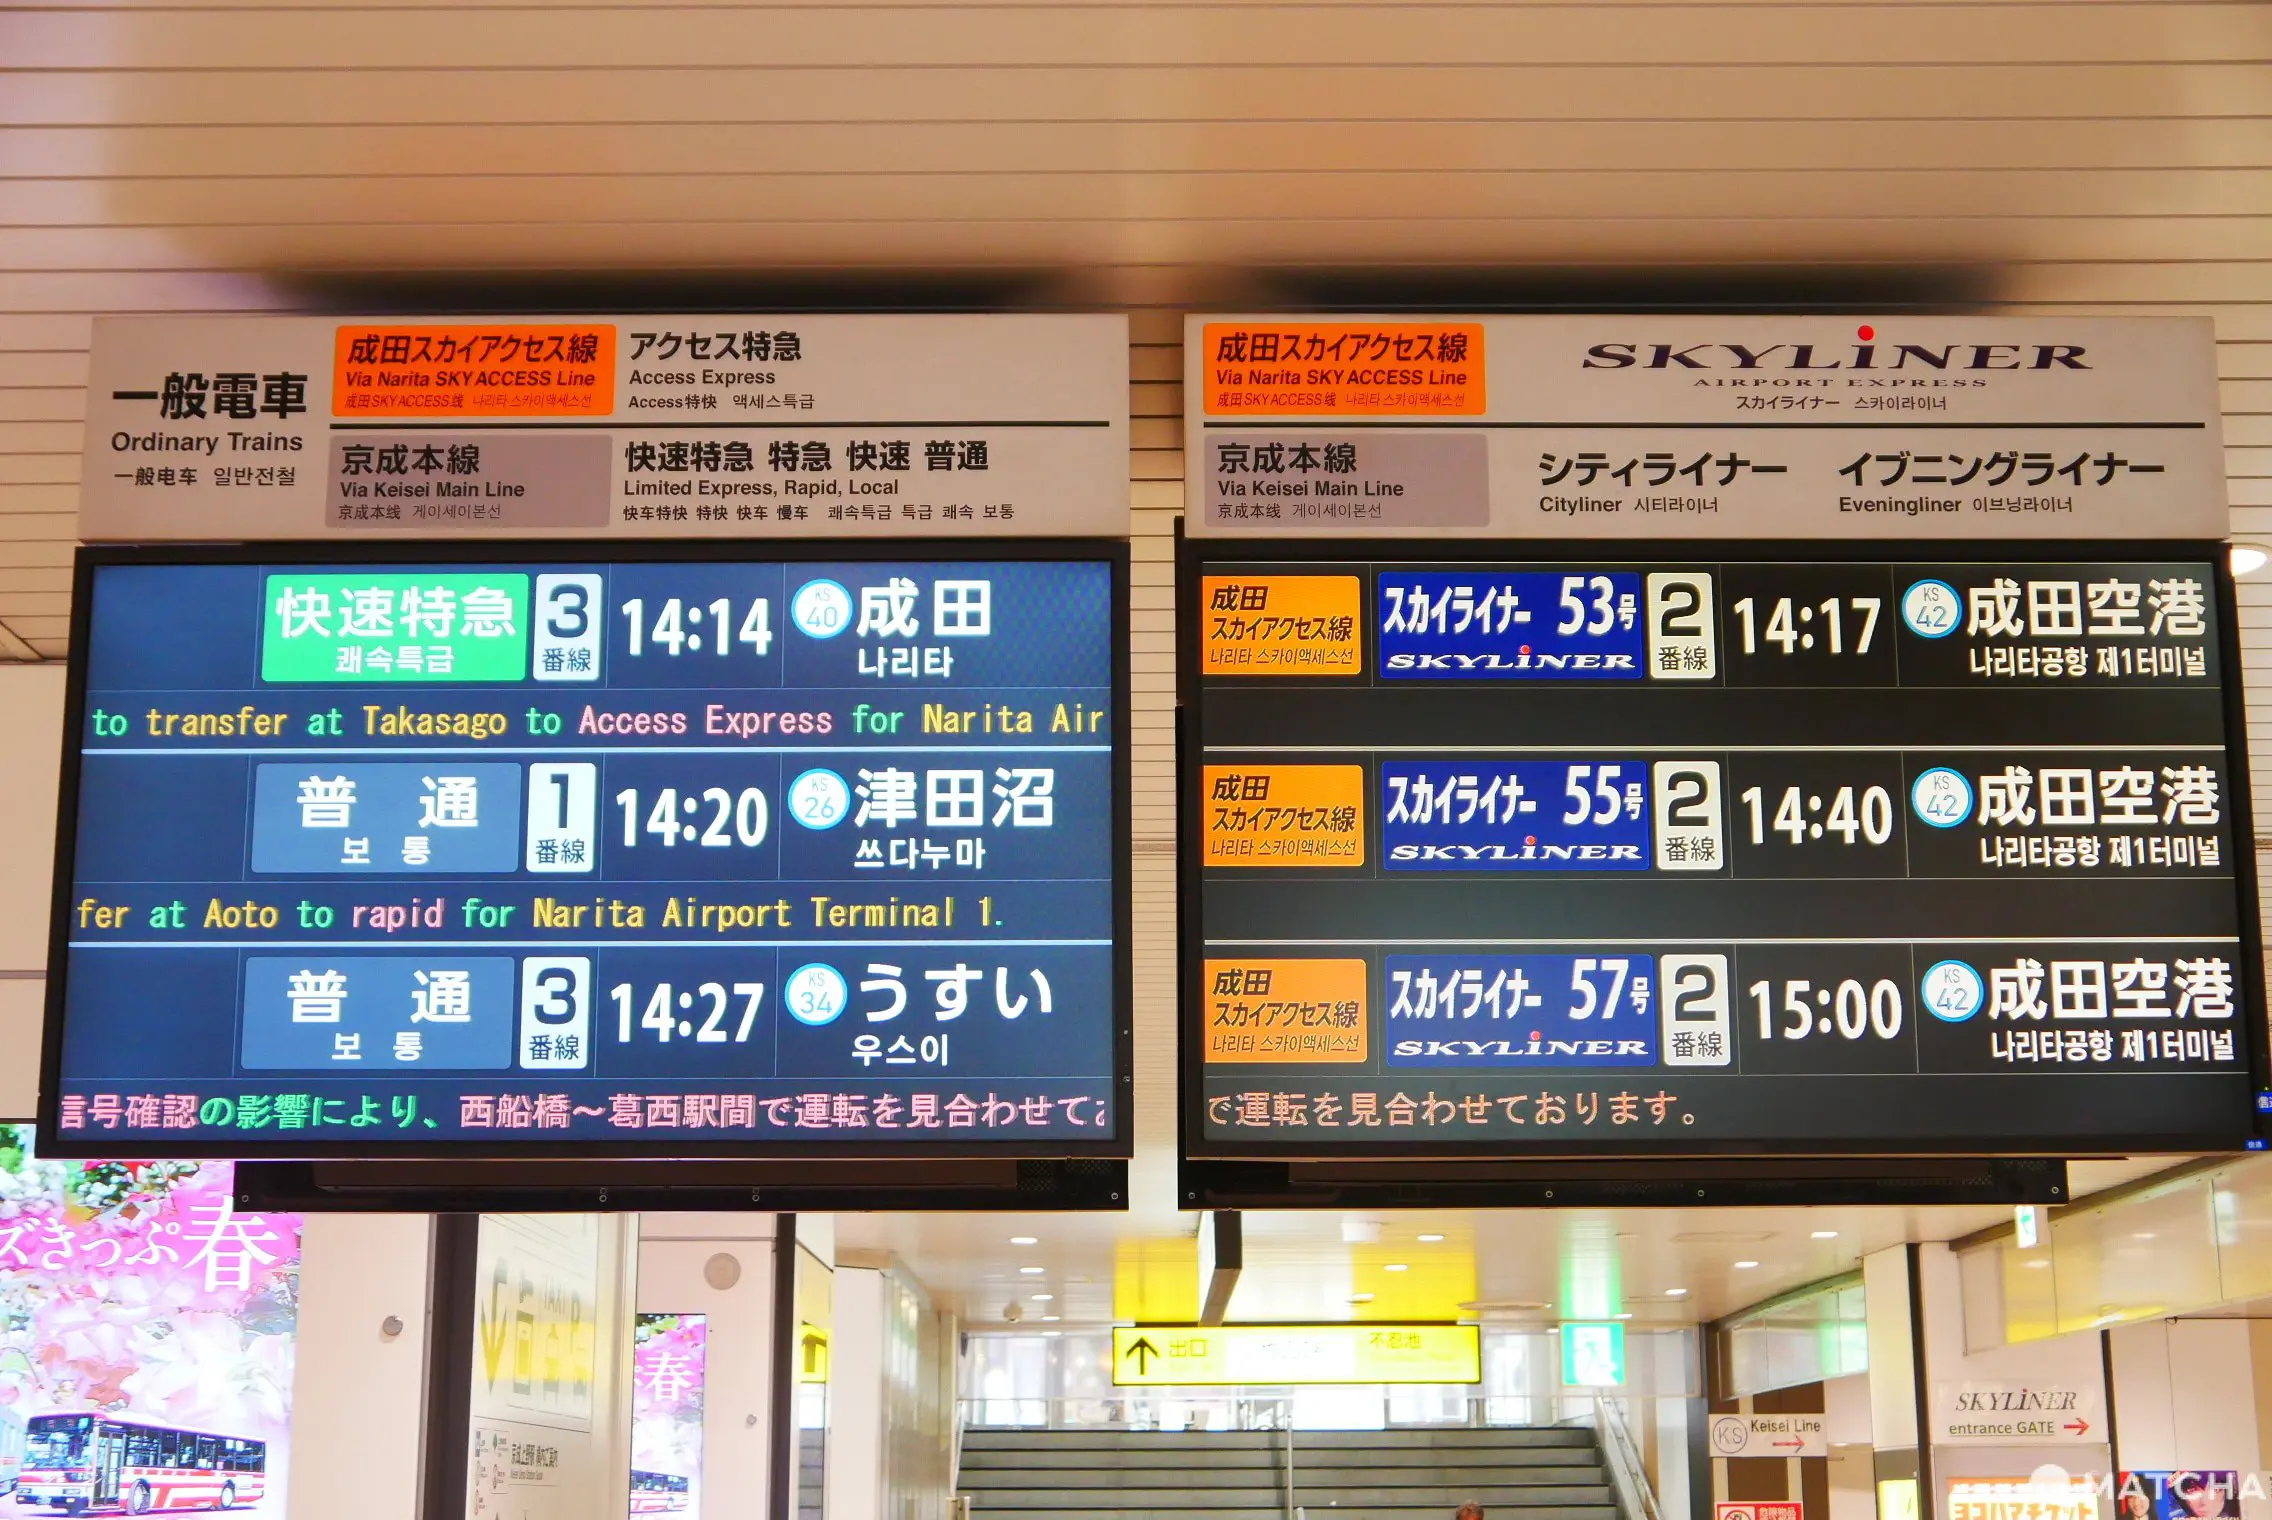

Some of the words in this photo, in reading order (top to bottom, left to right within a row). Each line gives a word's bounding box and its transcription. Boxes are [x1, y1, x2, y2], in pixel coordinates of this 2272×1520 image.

[348, 334, 598, 364] 成田スカイアクセス線
[630, 331, 801, 361] アクセス特急
[1217, 332, 1468, 363] 成田スカイアクセス線
[345, 371, 371, 387] Via
[377, 371, 429, 387] Narita
[557, 371, 595, 387] Line
[629, 369, 695, 384] Access
[702, 369, 775, 387] Express
[1216, 370, 1242, 385] Via
[1249, 370, 1300, 385] Narita
[1429, 370, 1466, 385] Line
[1693, 379, 1835, 387] AIRPORT
[1847, 379, 1988, 387] EXPRESS
[113, 372, 307, 419] 一般電車
[628, 394, 717, 409] Access特快
[733, 394, 815, 409] 액세스특급
[1737, 396, 1840, 410] スカイライナー
[1854, 396, 1947, 410] 스카이라이너
[111, 432, 219, 456] Ordinary
[227, 432, 303, 451] Trains
[625, 440, 753, 472] 快速特急
[768, 440, 832, 472] 特急
[846, 440, 910, 472] 快速
[924, 440, 989, 471] 普通
[1217, 442, 1357, 474] 京成本線
[341, 444, 480, 475] 京成本線
[1539, 452, 1787, 487] シティライナー
[1839, 451, 2164, 487] イブニングライナー
[114, 467, 197, 486] 一般电车
[214, 467, 295, 486] 일반전철
[340, 482, 368, 497] Via
[374, 482, 429, 497] Keisei
[436, 482, 479, 497] Main
[486, 482, 525, 497] Line
[624, 480, 692, 496] Limited
[698, 480, 778, 499] Express,
[784, 479, 842, 499] Rapid,
[849, 479, 898, 495] Local
[1217, 480, 1246, 496] Via
[1252, 480, 1308, 496] Keisei
[1315, 480, 1358, 496] Main
[1365, 480, 1404, 496] Line
[338, 505, 400, 520] 京成本线
[412, 504, 501, 519] 게이세이본선
[623, 505, 688, 521] 快车特快
[696, 505, 728, 521] 特快
[737, 505, 768, 520] 快车
[777, 505, 808, 520] 慢车
[828, 504, 891, 520] 쾌속특급
[901, 504, 932, 520] 특급
[942, 504, 973, 520] 쾌속
[983, 504, 1014, 520] 보통
[1217, 503, 1281, 519] 京成本线
[1293, 503, 1381, 519] 게이세이본선
[1540, 496, 1622, 515] Cityliner
[1634, 496, 1718, 514] 시티라이너
[1839, 497, 1962, 516] Eveningliner
[1973, 496, 2073, 513] 이브닝라이너
[1211, 584, 1269, 612] 成田
[1923, 587, 1939, 601] KS
[1966, 578, 2206, 637] 成田空港
[275, 585, 516, 639] 快速特急
[547, 583, 588, 639] 3
[806, 607, 837, 628] 40
[1383, 584, 1531, 635] スカイライナー
[1660, 582, 1702, 637] 2
[1916, 605, 1948, 628] 42
[621, 597, 773, 656] 14:14
[1210, 615, 1353, 642] スカイアクセス線
[1734, 597, 1882, 654] 14:17
[335, 645, 455, 674] 쾌속특급
[542, 647, 591, 673] 番線
[859, 646, 954, 678] 나리타
[1659, 645, 1709, 671] 番線
[1970, 646, 2087, 678] 나리타공항
[2097, 646, 2206, 678] 제1터미널
[92, 707, 128, 736] to
[146, 706, 288, 736] transfer
[307, 708, 343, 736] at
[364, 706, 507, 740] Takasago
[525, 708, 561, 736] to
[578, 705, 687, 735] Access
[705, 704, 833, 740] Express
[852, 704, 904, 734] for
[922, 704, 1032, 734] Narita
[1051, 705, 1104, 734] Air
[1211, 774, 1270, 802] 成田
[1933, 775, 1950, 790] KS
[1977, 765, 2220, 827] 成田空港
[549, 773, 570, 829] 1
[803, 798, 836, 819] 26
[854, 767, 1055, 828] 津田沼
[1387, 775, 1536, 825] スカイライナー
[1667, 770, 1709, 827] 2
[1927, 795, 1958, 817] 42
[616, 787, 769, 847] 14:20
[1211, 805, 1356, 833] スカイアクセス線
[1741, 785, 1893, 845] 14:40
[535, 837, 586, 865] 番線
[854, 838, 986, 870] 쓰다누마
[1665, 836, 1716, 863] 番線
[1980, 835, 2100, 868] 나리타공항
[2109, 835, 2220, 868] 제1터미널
[77, 899, 130, 929] fer
[149, 901, 187, 929] at
[203, 899, 280, 929] Aoto
[297, 901, 334, 929] to
[352, 898, 445, 933] rapid
[461, 898, 516, 929] for
[532, 898, 646, 928] Narita
[662, 897, 791, 932] Airport
[811, 897, 954, 927] Terminal
[808, 971, 825, 987] KS
[1212, 968, 1271, 996] 成田
[1943, 967, 1960, 984] KS
[1987, 957, 2234, 1021] 成田空港
[534, 967, 577, 1025] 3
[800, 992, 833, 1014] 34
[859, 964, 1052, 1022] うすい
[1390, 968, 1541, 1020] スカイライナー
[1674, 964, 1718, 1022] 2
[1935, 987, 1969, 1011] 42
[611, 983, 765, 1043] 14:27
[1213, 1001, 1360, 1029] スカイアクセス線
[1749, 978, 1902, 1041] 15:00
[528, 1034, 580, 1061] 番線
[851, 1034, 948, 1066] 우스이
[1671, 1031, 1723, 1058] 番線
[1991, 1029, 2113, 1062] 나리타공항
[2121, 1029, 2234, 1062] 제1터미널
[1208, 1092, 1697, 1127] で運転を見合わせております。
[1169, 1338, 1208, 1358] 出口
[1370, 1332, 1422, 1350] 不忍池
[1717, 1424, 1745, 1444] KS
[1750, 1419, 1789, 1433] Keisei
[1795, 1419, 1821, 1433] Line
[1949, 1422, 2012, 1435] entrance
[2017, 1421, 2055, 1435] GATE
